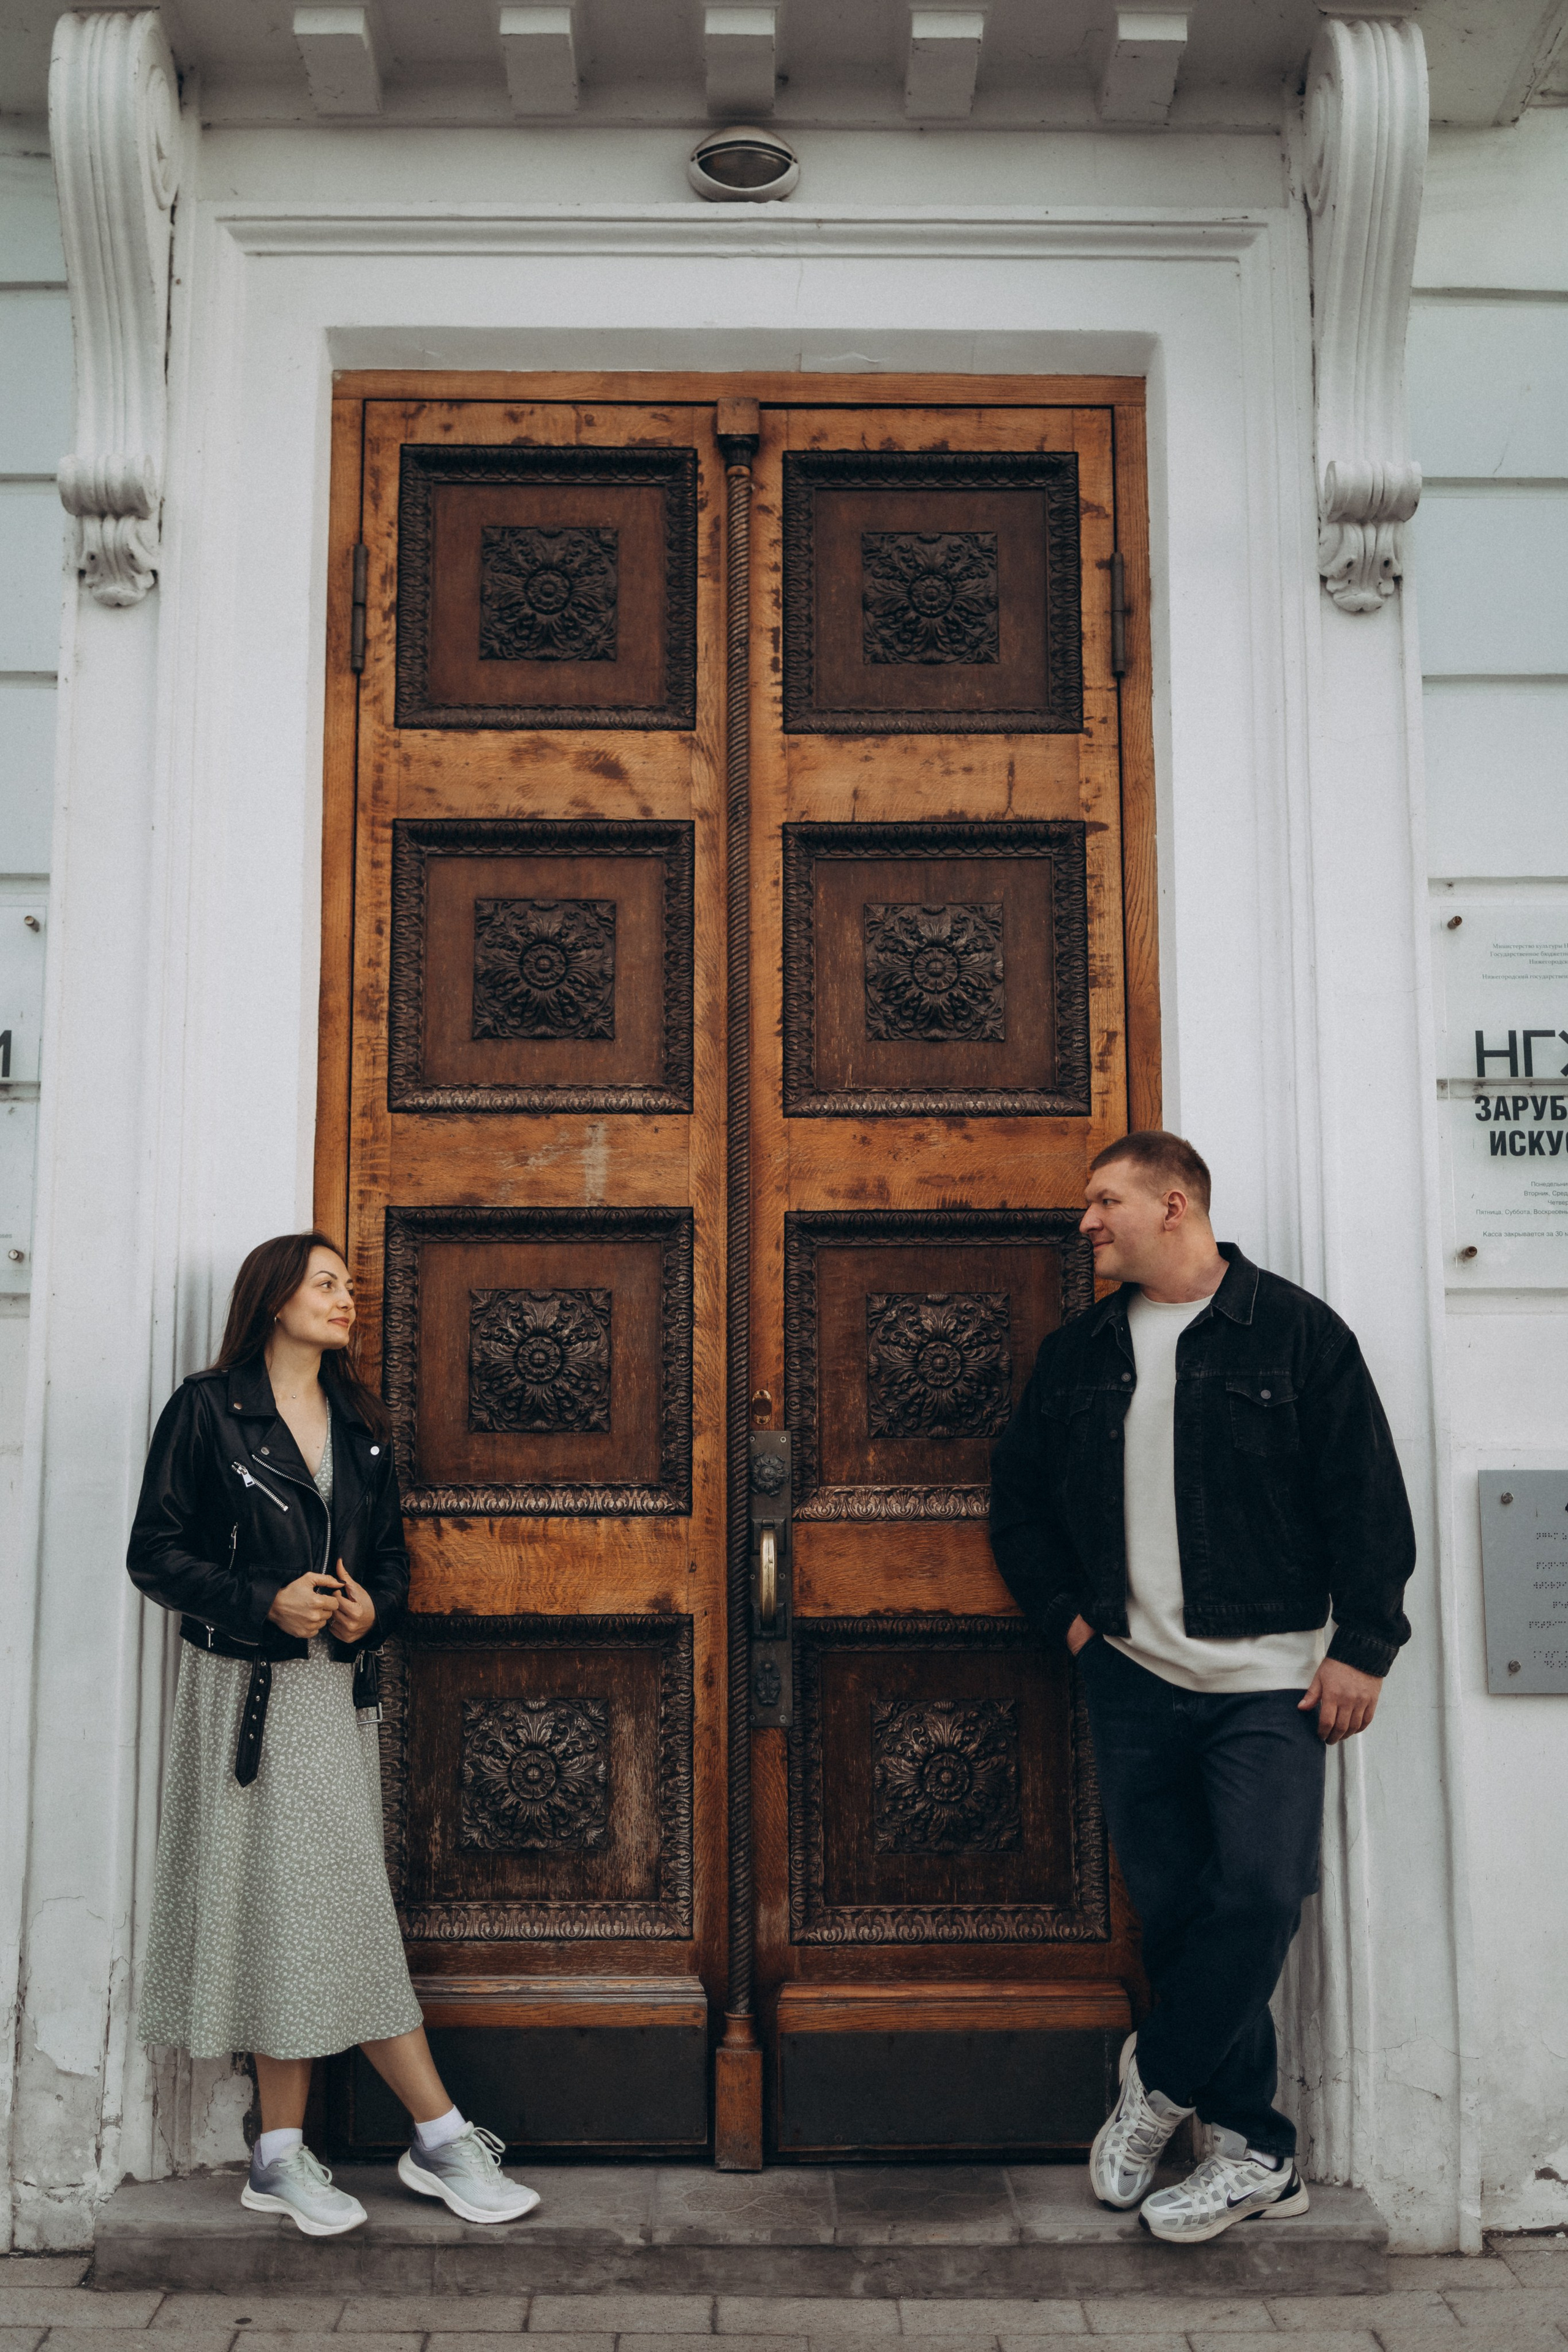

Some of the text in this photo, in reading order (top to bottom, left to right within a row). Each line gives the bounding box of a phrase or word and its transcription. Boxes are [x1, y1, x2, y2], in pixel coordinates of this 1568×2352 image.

[1475, 1030, 1568, 1077] НГ
[1474, 1095, 1568, 1121] ЗАРУБ
[1489, 1130, 1568, 1156] ИСКУ
